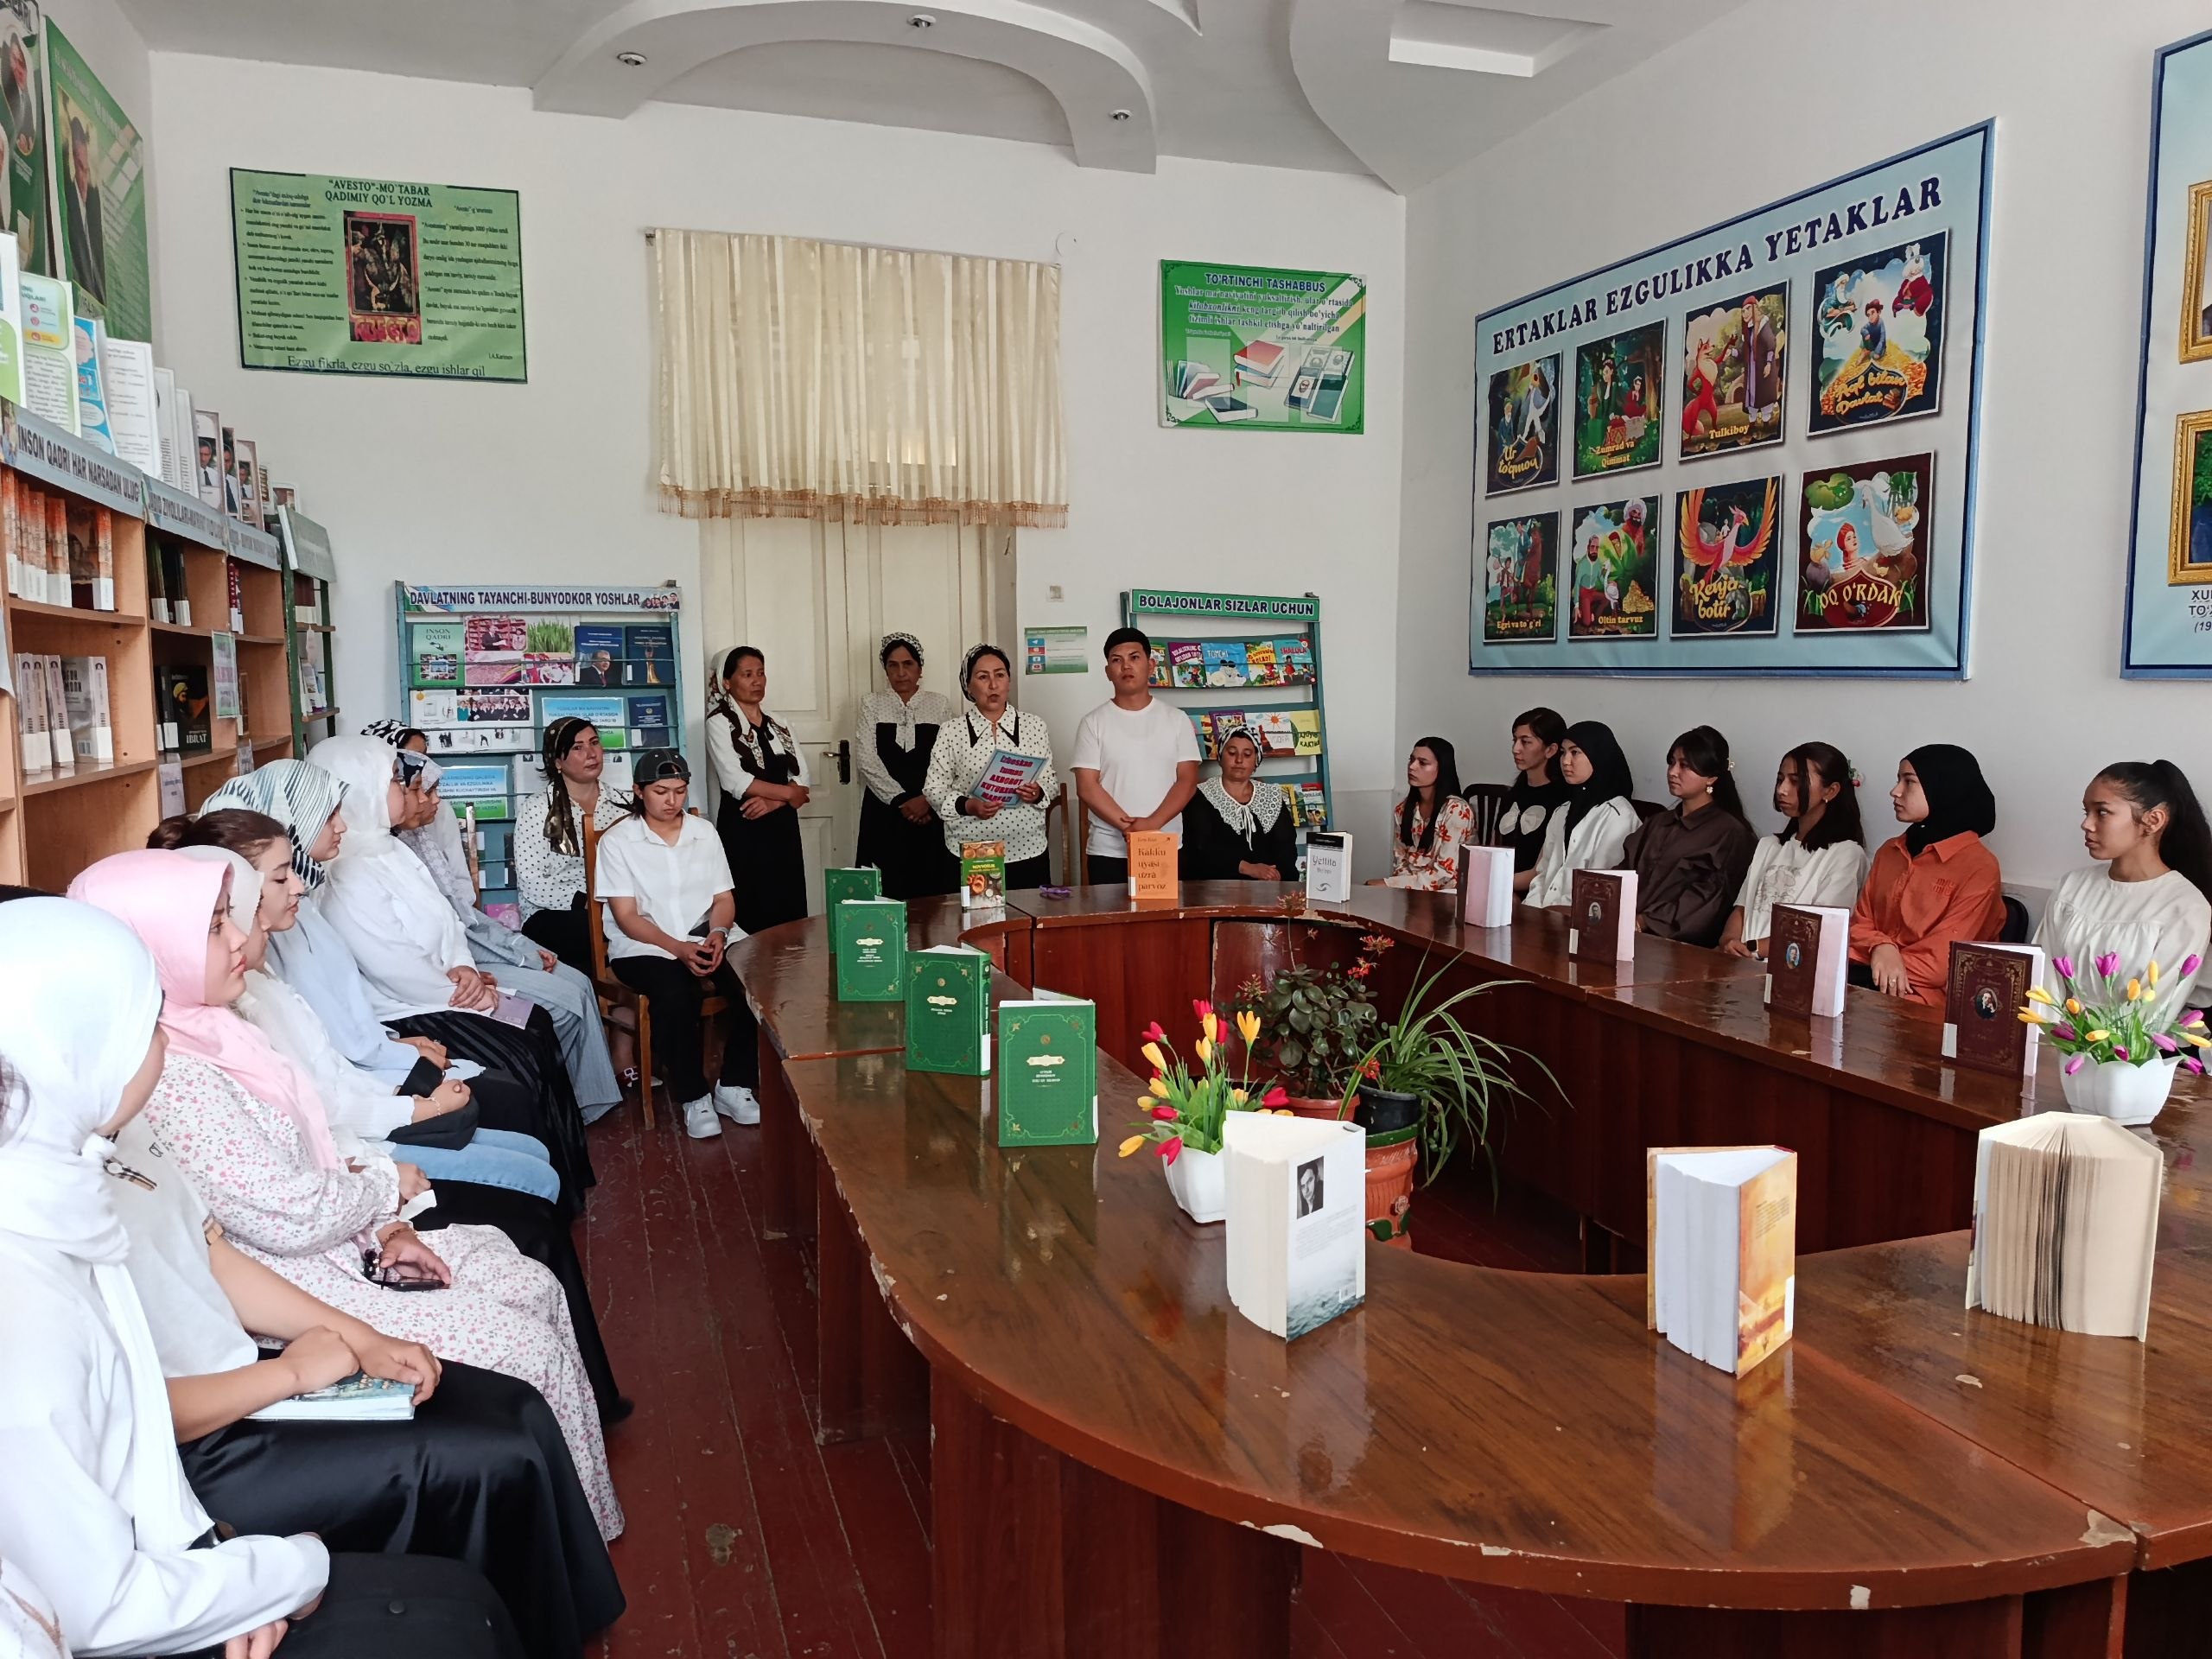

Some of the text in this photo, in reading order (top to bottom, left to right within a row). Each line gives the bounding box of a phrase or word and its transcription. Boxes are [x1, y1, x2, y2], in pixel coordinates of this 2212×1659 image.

[325, 190, 369, 203] QADIMIY
[397, 196, 433, 207] YOZMA
[1493, 176, 1942, 354] ERTAKLAR EZGULIKKA YETAKLAR
[1205, 273, 1325, 292] TO'RTINCHI TASHABBUS
[288, 355, 315, 368] Ezgu
[352, 362, 376, 372] ezgu
[415, 365, 439, 374] ezgu
[442, 364, 468, 374] ishlar
[472, 365, 486, 378] qil
[1709, 424, 1750, 439] Tulkiboy
[1595, 441, 1624, 454] Zumrad
[17, 424, 44, 461] INSON
[47, 440, 71, 473] QADRI
[72, 452, 86, 480] HAR
[87, 460, 122, 494] NARSADAN
[1601, 454, 1630, 468] Qimmat
[410, 592, 640, 606] DAVLATNING TAYANCHI-BUNYODKOR YOSHLAR
[2191, 589, 2212, 601] XU
[1139, 594, 1313, 615] BOLAJONLAR SIZLAR UCHUN
[1698, 600, 1731, 620] botir
[1599, 616, 1617, 625] Oltin
[186, 734, 207, 744] IBRAT
[1138, 848, 1166, 856] Kakku
